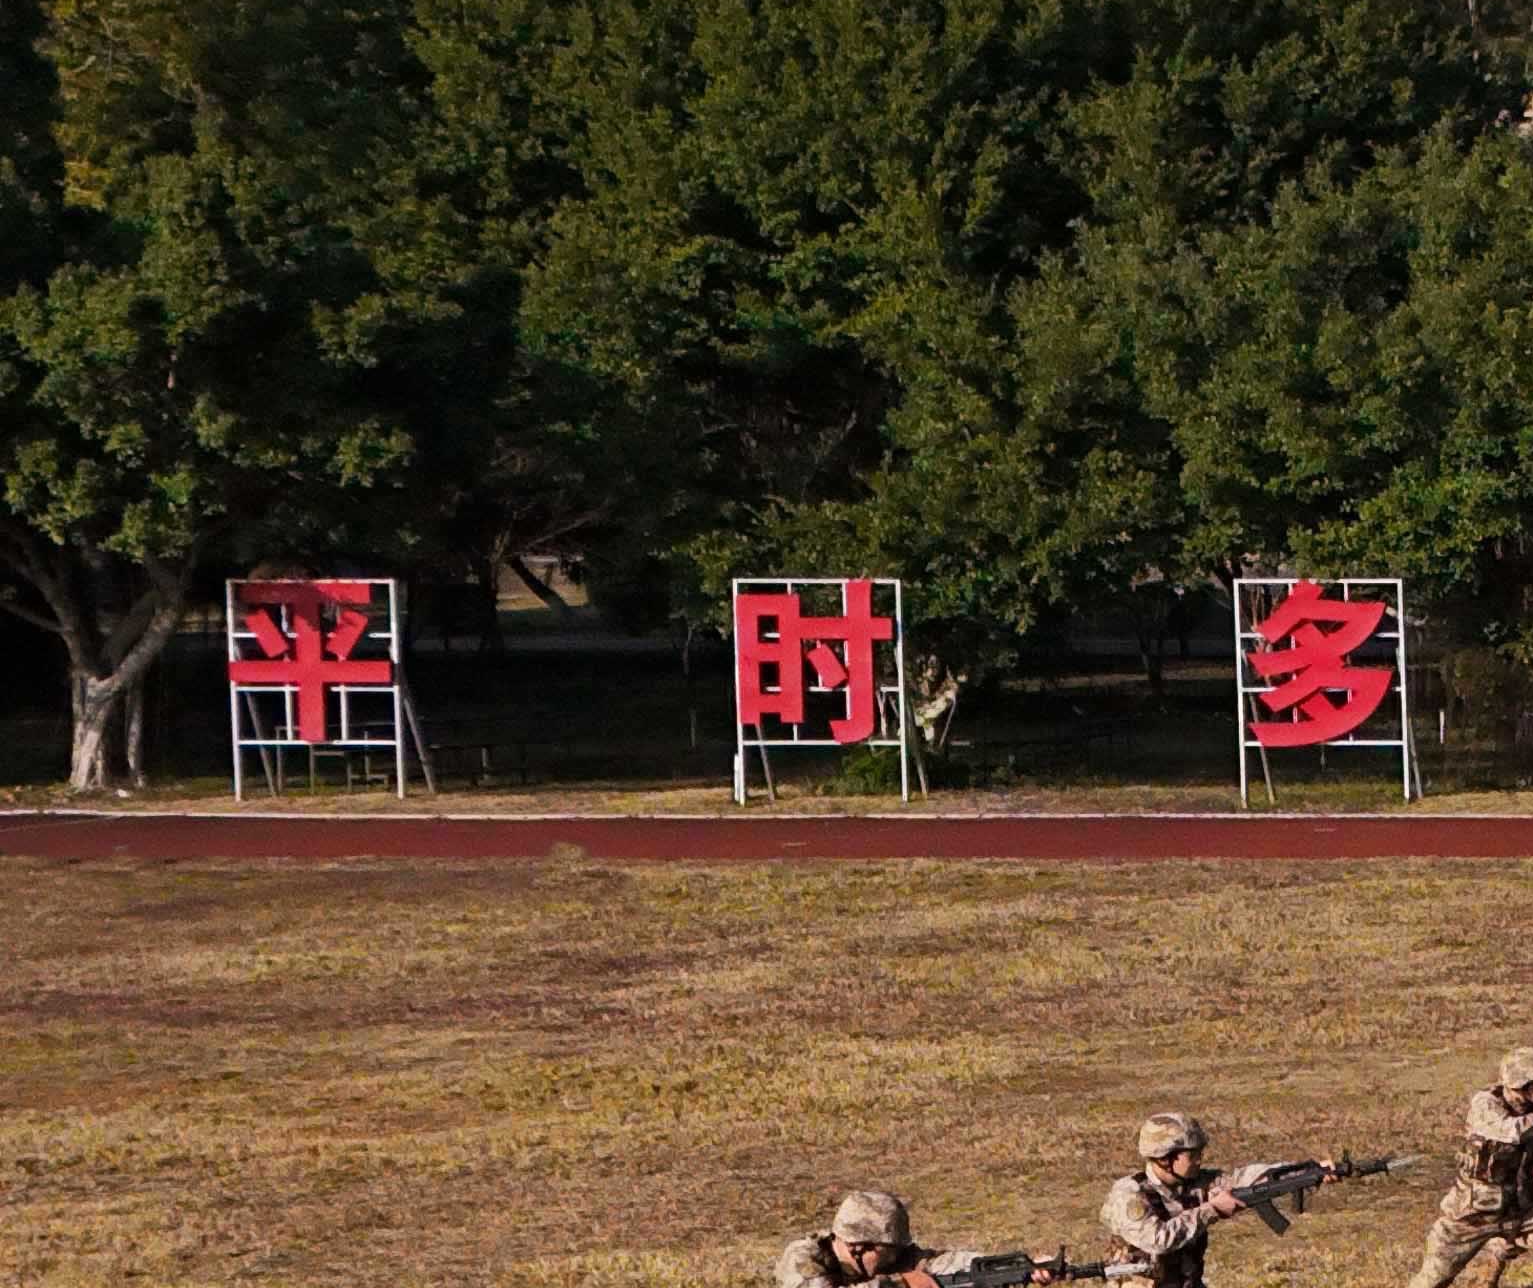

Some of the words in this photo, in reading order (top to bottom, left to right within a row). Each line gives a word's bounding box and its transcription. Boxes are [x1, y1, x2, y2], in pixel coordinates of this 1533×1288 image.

[228, 581, 393, 741] 平
[737, 580, 892, 743] 时
[1246, 580, 1394, 747] 多
